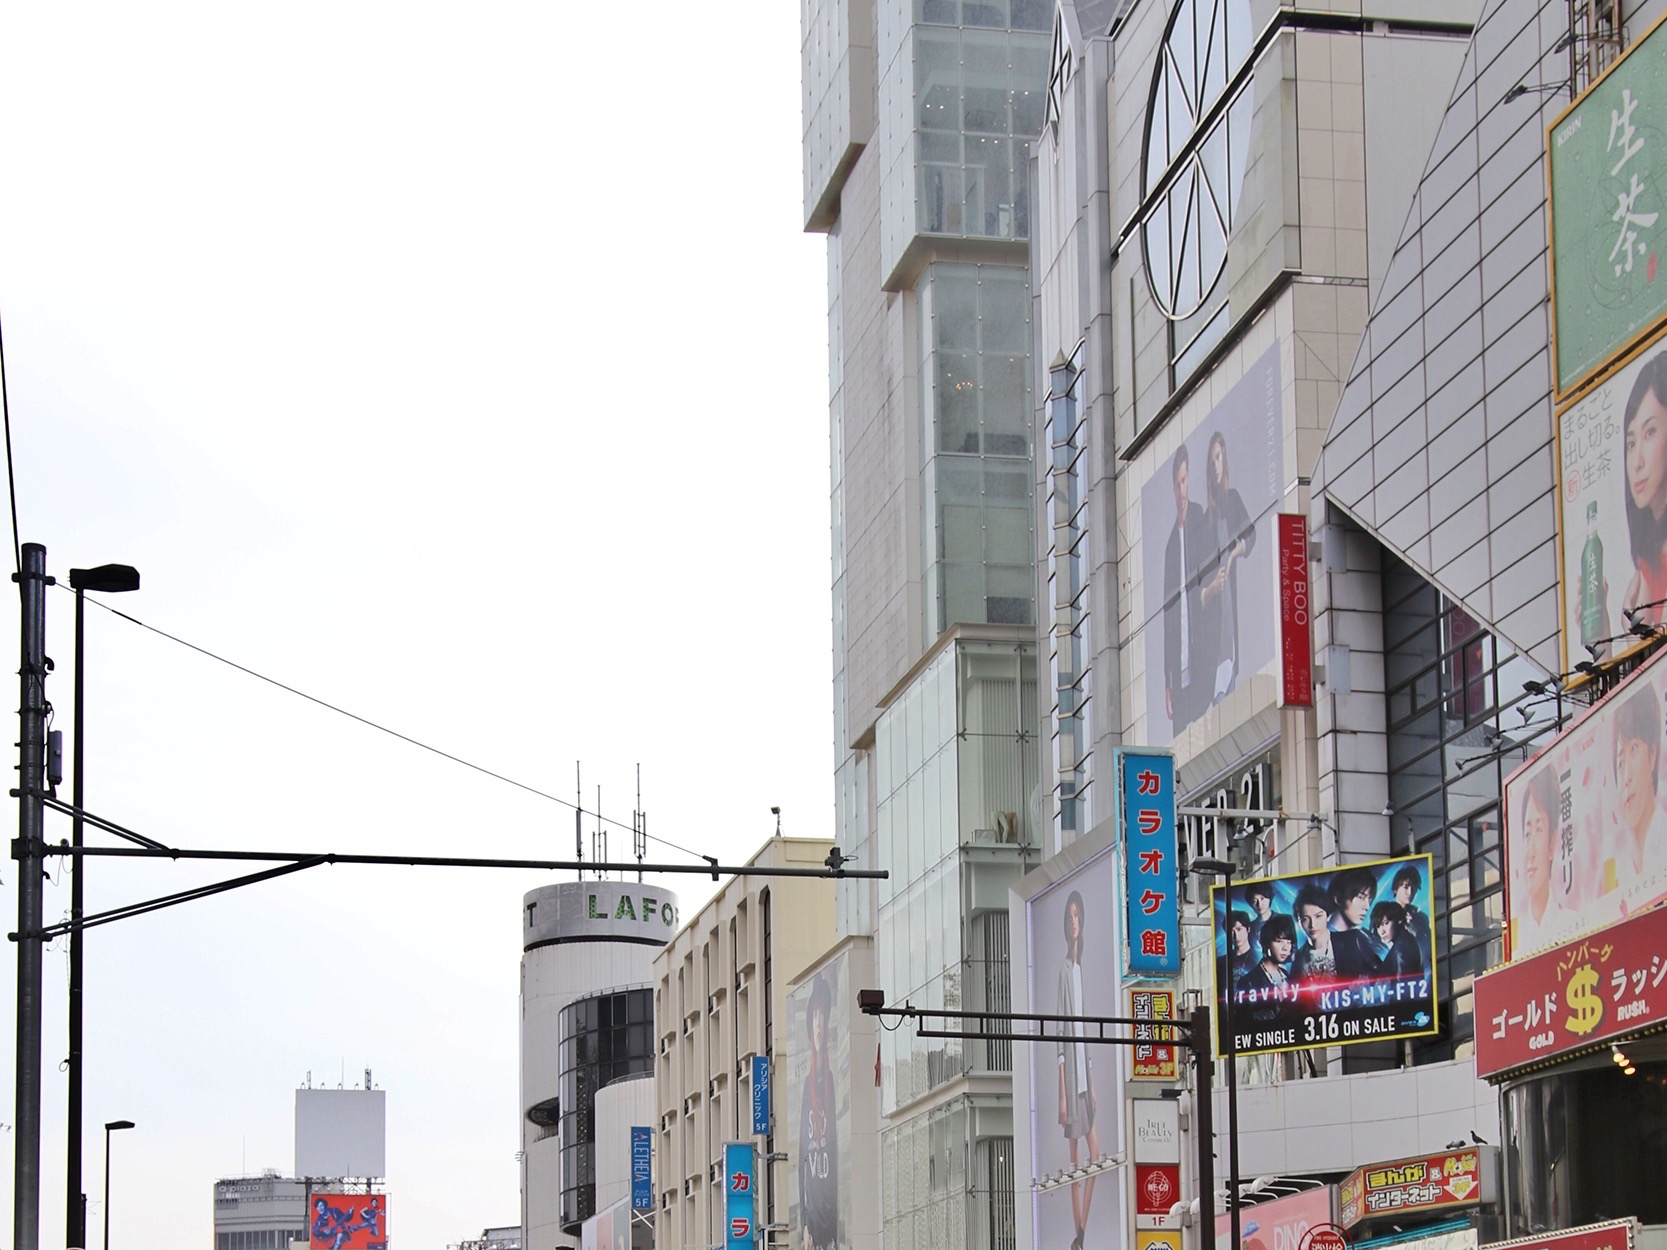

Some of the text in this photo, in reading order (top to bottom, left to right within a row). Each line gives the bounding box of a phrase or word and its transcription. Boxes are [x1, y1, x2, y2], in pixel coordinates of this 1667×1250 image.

[1557, 115, 1582, 147] KIRIN
[1606, 89, 1659, 277] 生茶
[1564, 389, 1613, 440] まるごと
[1582, 449, 1612, 491] 生茶
[1282, 549, 1290, 576] Party
[1292, 521, 1308, 625] TITTY BOO
[1283, 590, 1291, 622] Space
[1233, 763, 1264, 840] 21
[1137, 769, 1167, 957] カラオケ館
[1557, 941, 1614, 981] ハンバーグ
[1225, 980, 1428, 1010] ravity KIS-MY-FT2
[1235, 1014, 1395, 1049] EW SINGLE 3.16 ON SALE
[1492, 992, 1557, 1040] ゴールド
[1529, 1000, 1646, 1050] GOLD RUSH
[756, 1123, 767, 1131] 5F
[634, 1131, 650, 1184] ALETHEIA
[1367, 1163, 1426, 1188] まんが
[636, 1198, 649, 1207] 5F
[1366, 1183, 1443, 1211] インターネット
[1152, 1216, 1166, 1226] 1F
